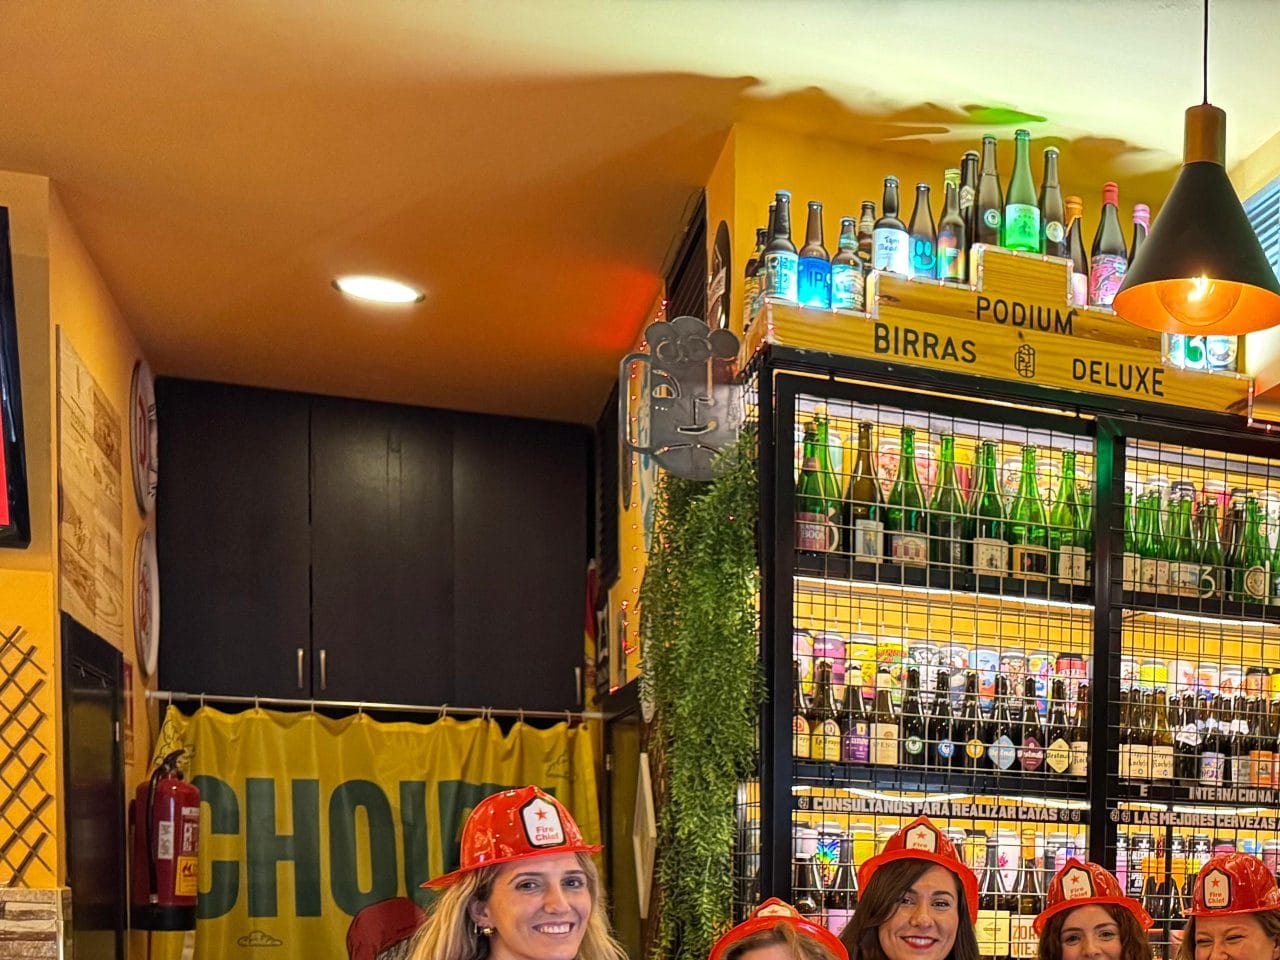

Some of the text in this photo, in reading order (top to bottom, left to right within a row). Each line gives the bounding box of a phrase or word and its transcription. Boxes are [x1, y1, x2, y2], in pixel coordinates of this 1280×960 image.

[976, 296, 1074, 336] PODIUM
[874, 323, 977, 365] BIRRAS
[1072, 357, 1165, 397] DELUXE
[914, 801, 950, 816] PARA
[952, 803, 1017, 819] REALIZAR
[1018, 806, 1058, 821] CATAS
[1134, 811, 1160, 824] LAS
[1160, 813, 1215, 828] MEJORES
[1216, 815, 1276, 831] CERVEZAS
[535, 833, 560, 842] Chief
[536, 826, 554, 834] Fire
